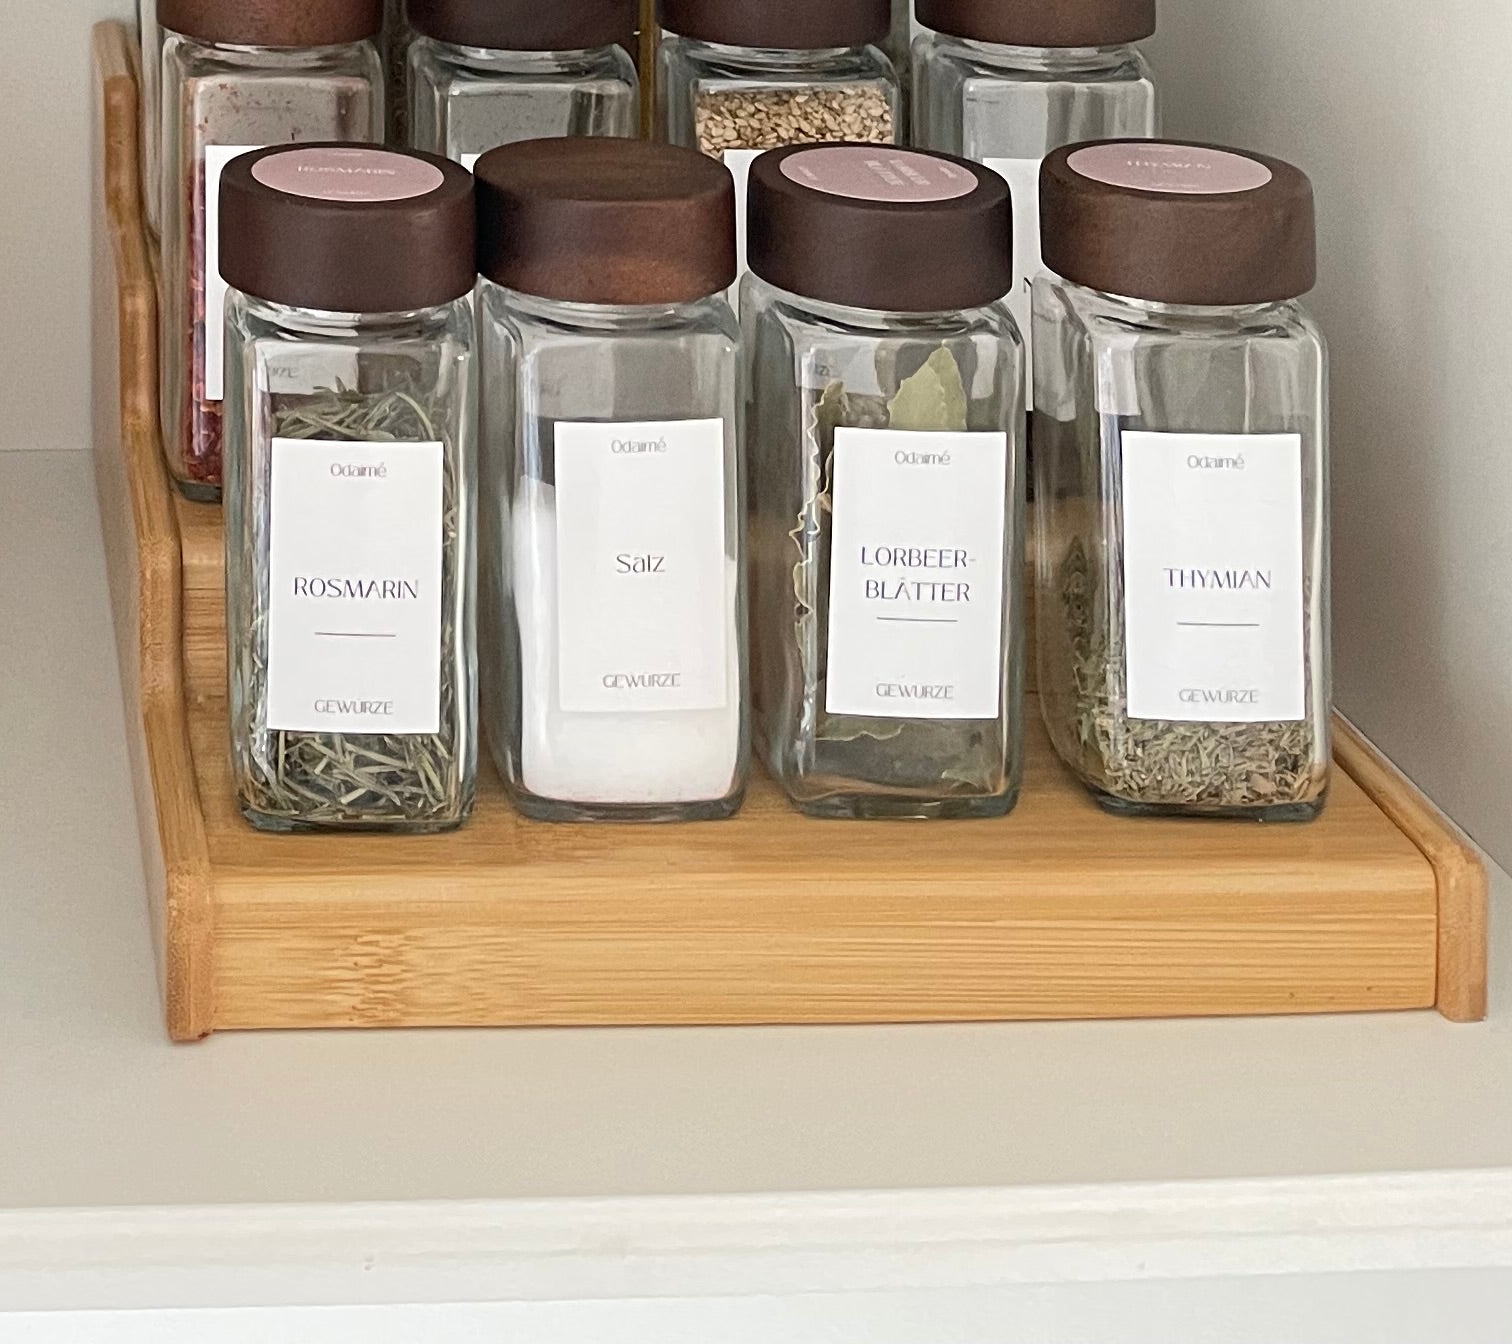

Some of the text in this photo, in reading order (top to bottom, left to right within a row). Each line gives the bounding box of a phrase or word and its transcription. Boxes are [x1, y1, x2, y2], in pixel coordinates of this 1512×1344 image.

[611, 436, 666, 453] Odaimé
[895, 450, 950, 465] Odaimé
[1187, 453, 1245, 470] Odaimé
[330, 462, 387, 478] Odaimé
[616, 554, 666, 573] Salz
[862, 546, 976, 568] LORBEER-
[294, 577, 419, 599] ROSMARIN
[1163, 568, 1271, 589] THYMIAN
[866, 577, 970, 602] BLÄTTER
